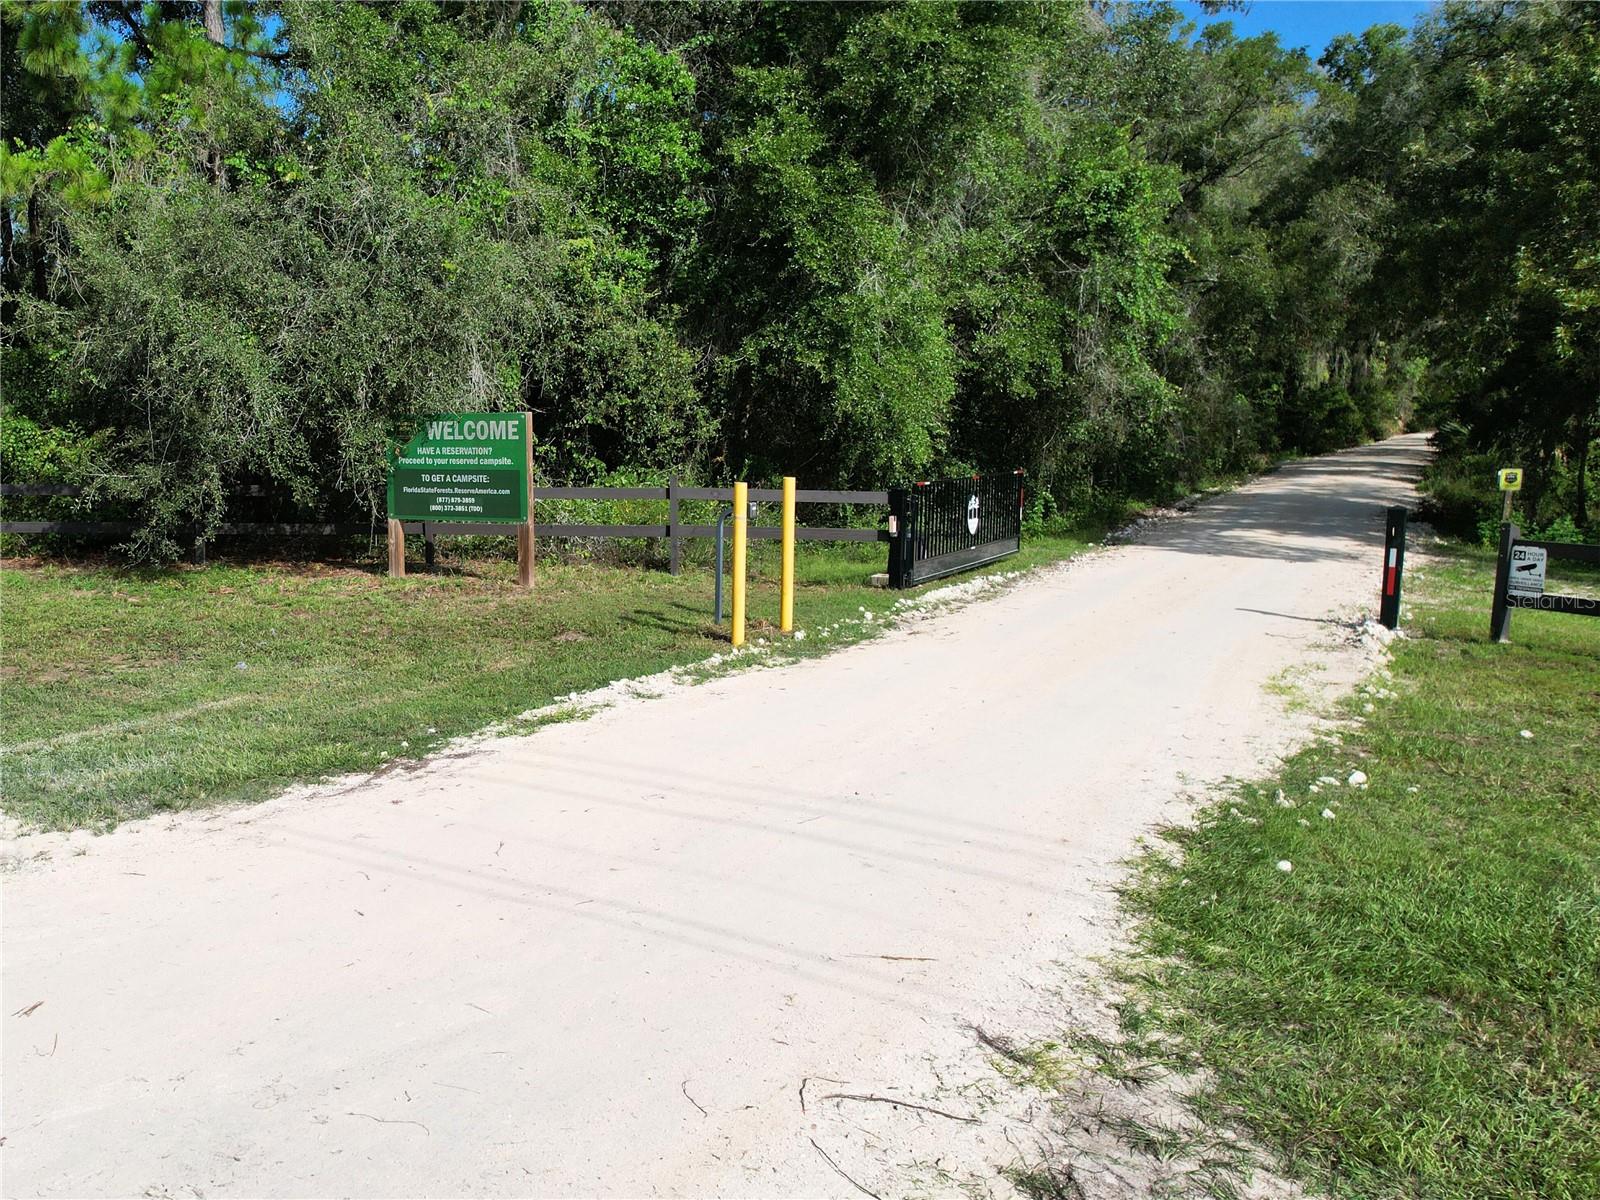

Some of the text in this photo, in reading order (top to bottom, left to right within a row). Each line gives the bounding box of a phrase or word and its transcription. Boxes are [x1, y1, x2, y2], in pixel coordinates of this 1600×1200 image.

[427, 420, 519, 441] WELCOME
[417, 447, 434, 455] HAVE
[442, 448, 492, 456] RESERVATION?
[398, 456, 424, 464] Proceed
[434, 458, 448, 466] your
[450, 457, 478, 465] reserved
[480, 457, 514, 466] campsite.
[422, 474, 430, 482] TO
[452, 474, 490, 483] CAMPSITE:
[403, 486, 510, 495] FloridaStateForests.ReserveAmerica.com
[1514, 552, 1525, 560] 24
